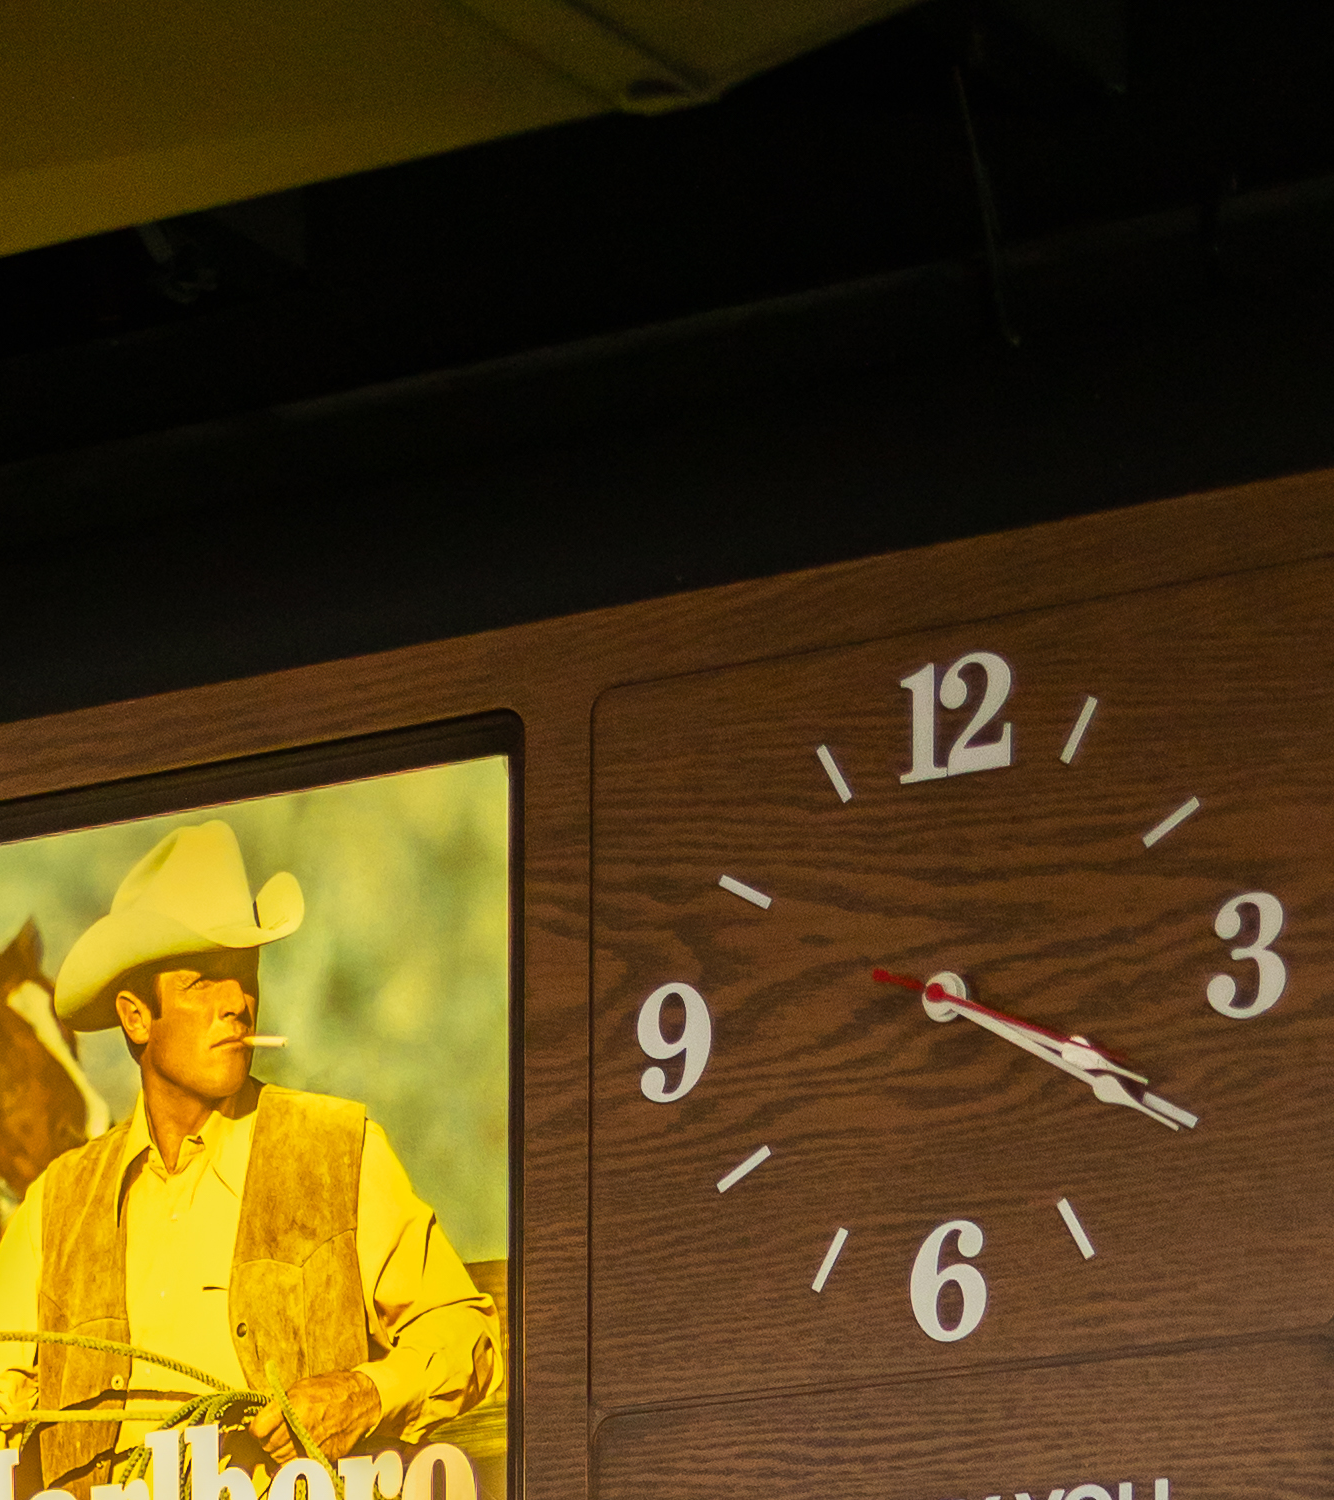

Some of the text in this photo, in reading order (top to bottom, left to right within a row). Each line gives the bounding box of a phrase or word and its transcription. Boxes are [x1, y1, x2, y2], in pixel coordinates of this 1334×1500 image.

[900, 652, 1011, 784] 12
[1206, 892, 1287, 1018] 3
[637, 982, 712, 1103] 9
[910, 1219, 988, 1342] 6
